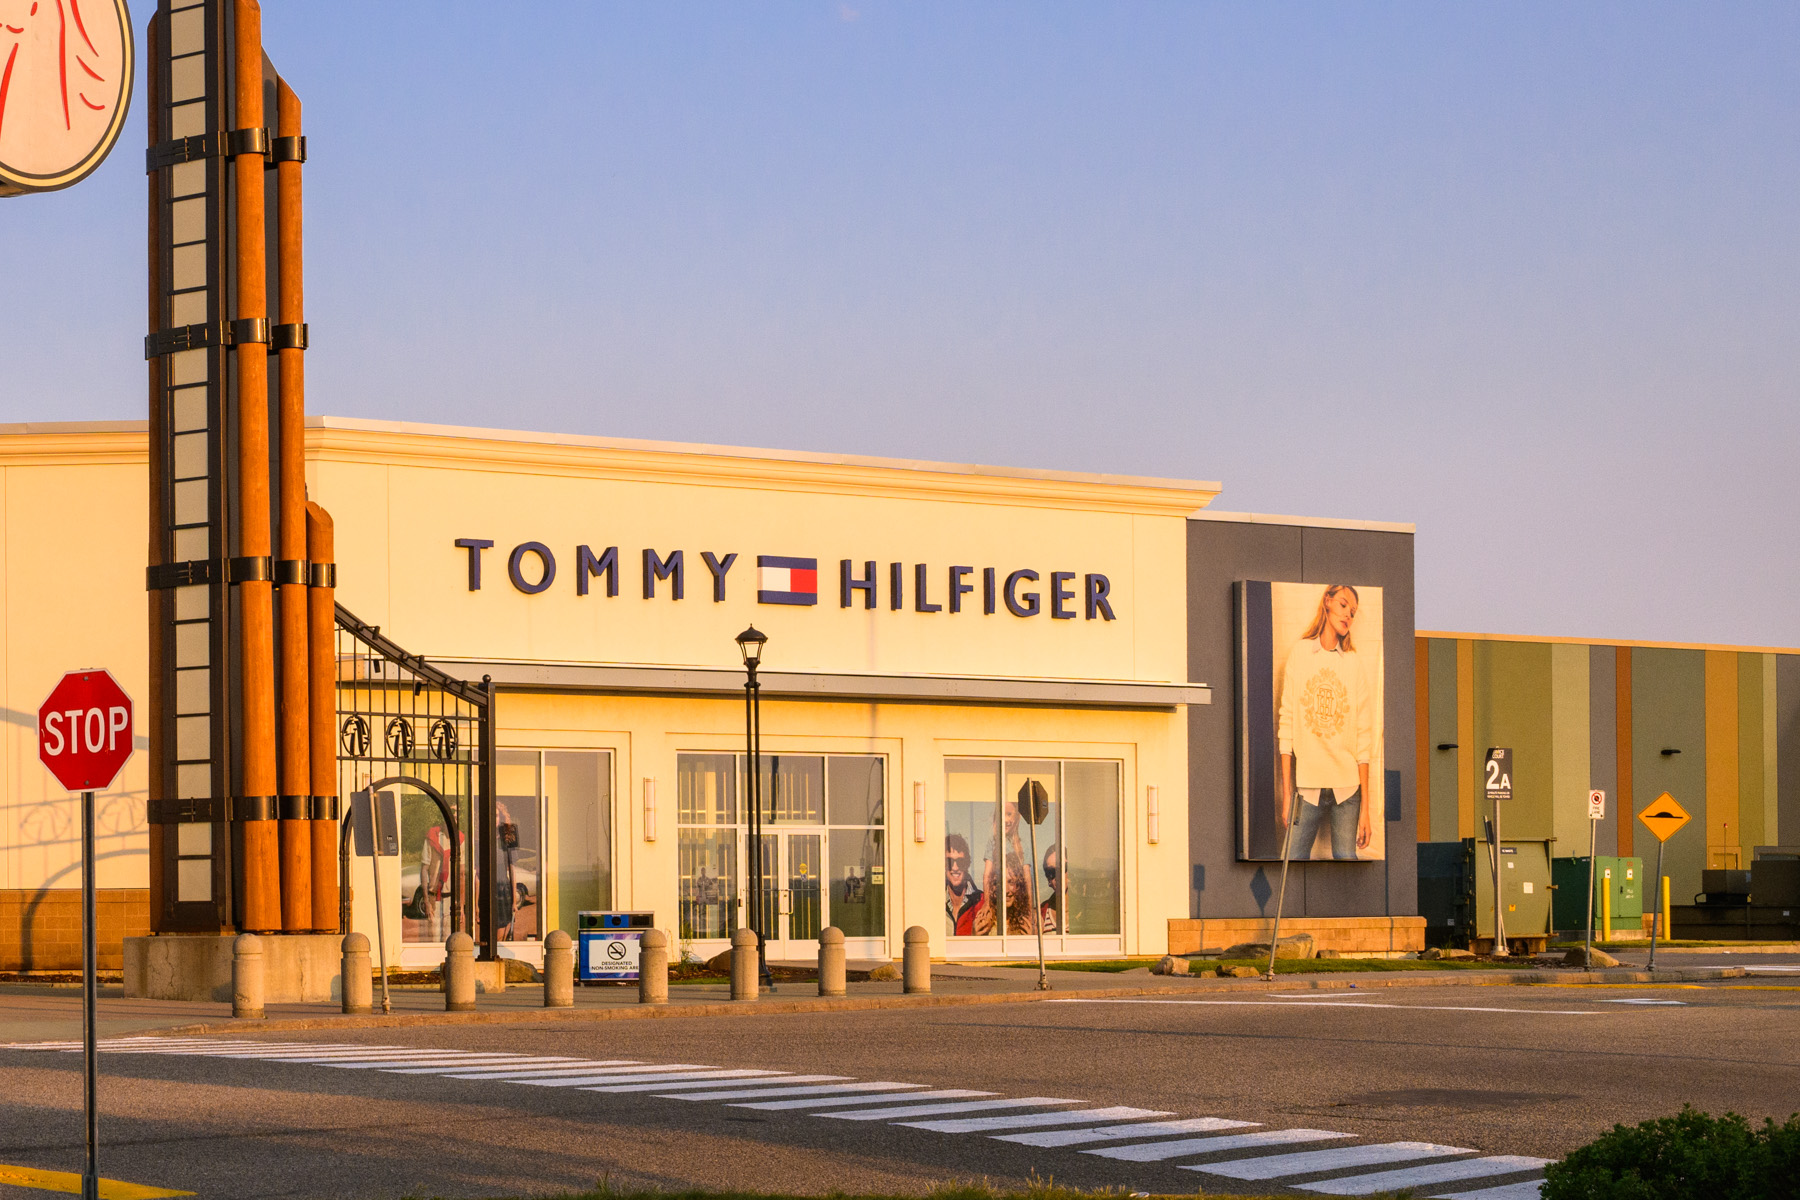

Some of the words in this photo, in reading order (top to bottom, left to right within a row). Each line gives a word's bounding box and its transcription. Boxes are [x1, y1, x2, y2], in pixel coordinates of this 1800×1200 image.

[455, 538, 738, 603] TOMMY
[840, 558, 1117, 621] HILFIGER
[44, 706, 128, 756] STOP
[1486, 759, 1511, 790] 2A
